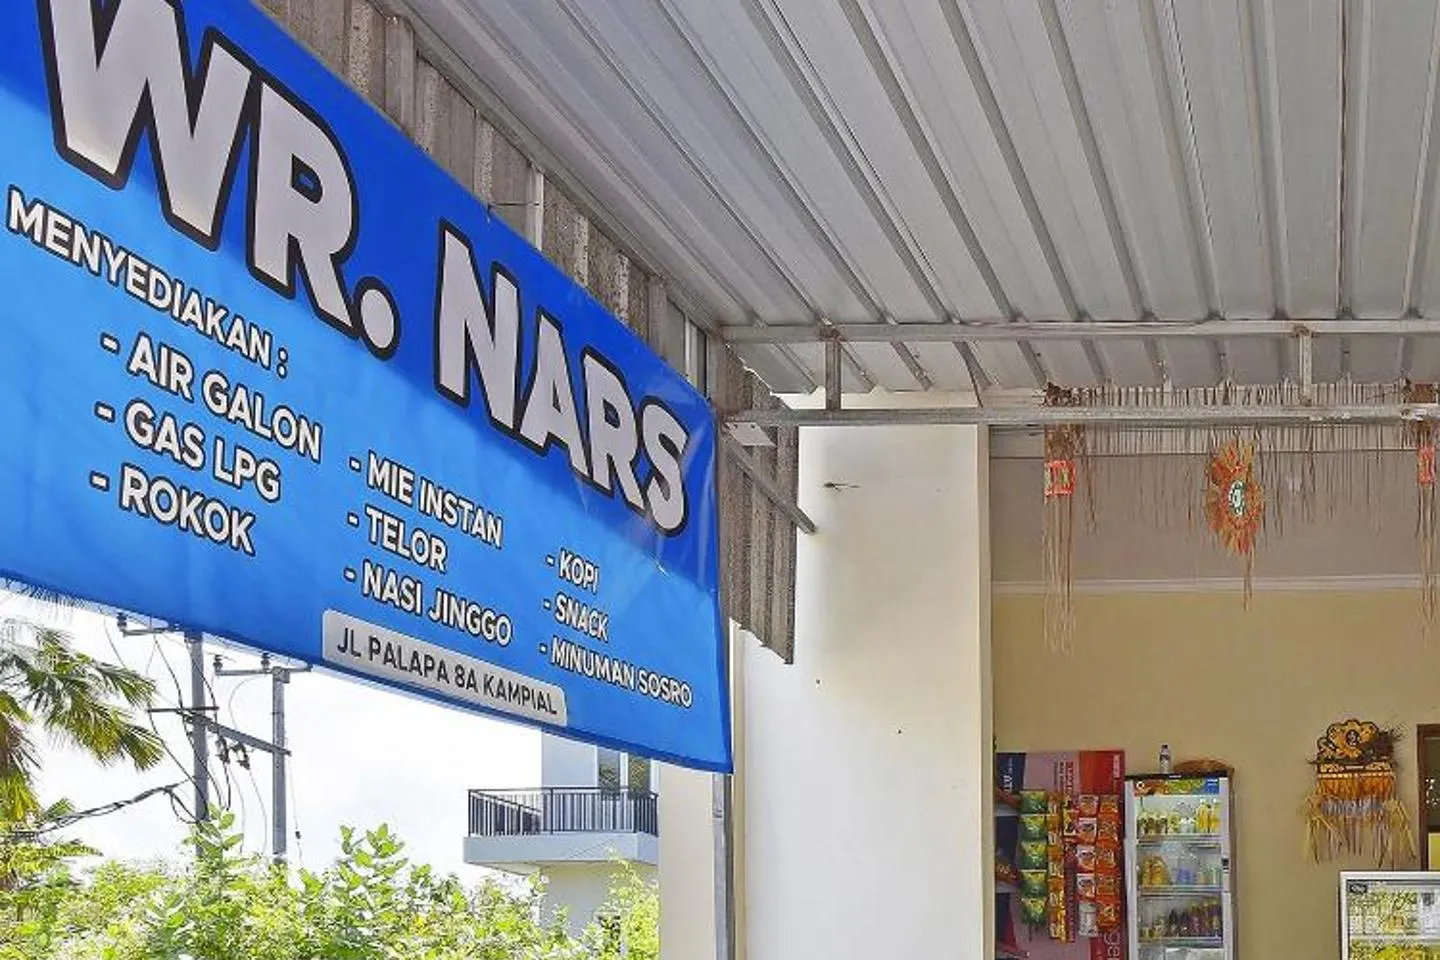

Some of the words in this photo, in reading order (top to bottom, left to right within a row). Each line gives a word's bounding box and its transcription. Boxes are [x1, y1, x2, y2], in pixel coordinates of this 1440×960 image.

[7, 184, 273, 369] MENYEDIAKAN
[42, 0, 400, 358] WR.
[433, 218, 692, 537] NARS
[127, 331, 195, 402] AIR
[201, 370, 323, 463] GALON
[124, 398, 206, 470] GAS
[213, 436, 281, 502] LPG
[119, 463, 257, 556] ROKOK
[364, 503, 448, 574] TELOR
[366, 449, 415, 507] MIE
[418, 476, 504, 550] INSTAN
[361, 558, 423, 616] NASI
[428, 589, 513, 647] JINGGO
[554, 591, 610, 643] SNACK
[558, 548, 600, 595] KOPI
[337, 627, 362, 658] JL
[368, 634, 450, 685] PALAPA
[454, 664, 479, 694] 8A
[482, 672, 558, 715] KAMPIAL
[550, 635, 636, 692] MINUMAN
[637, 666, 694, 709] SOSRO
